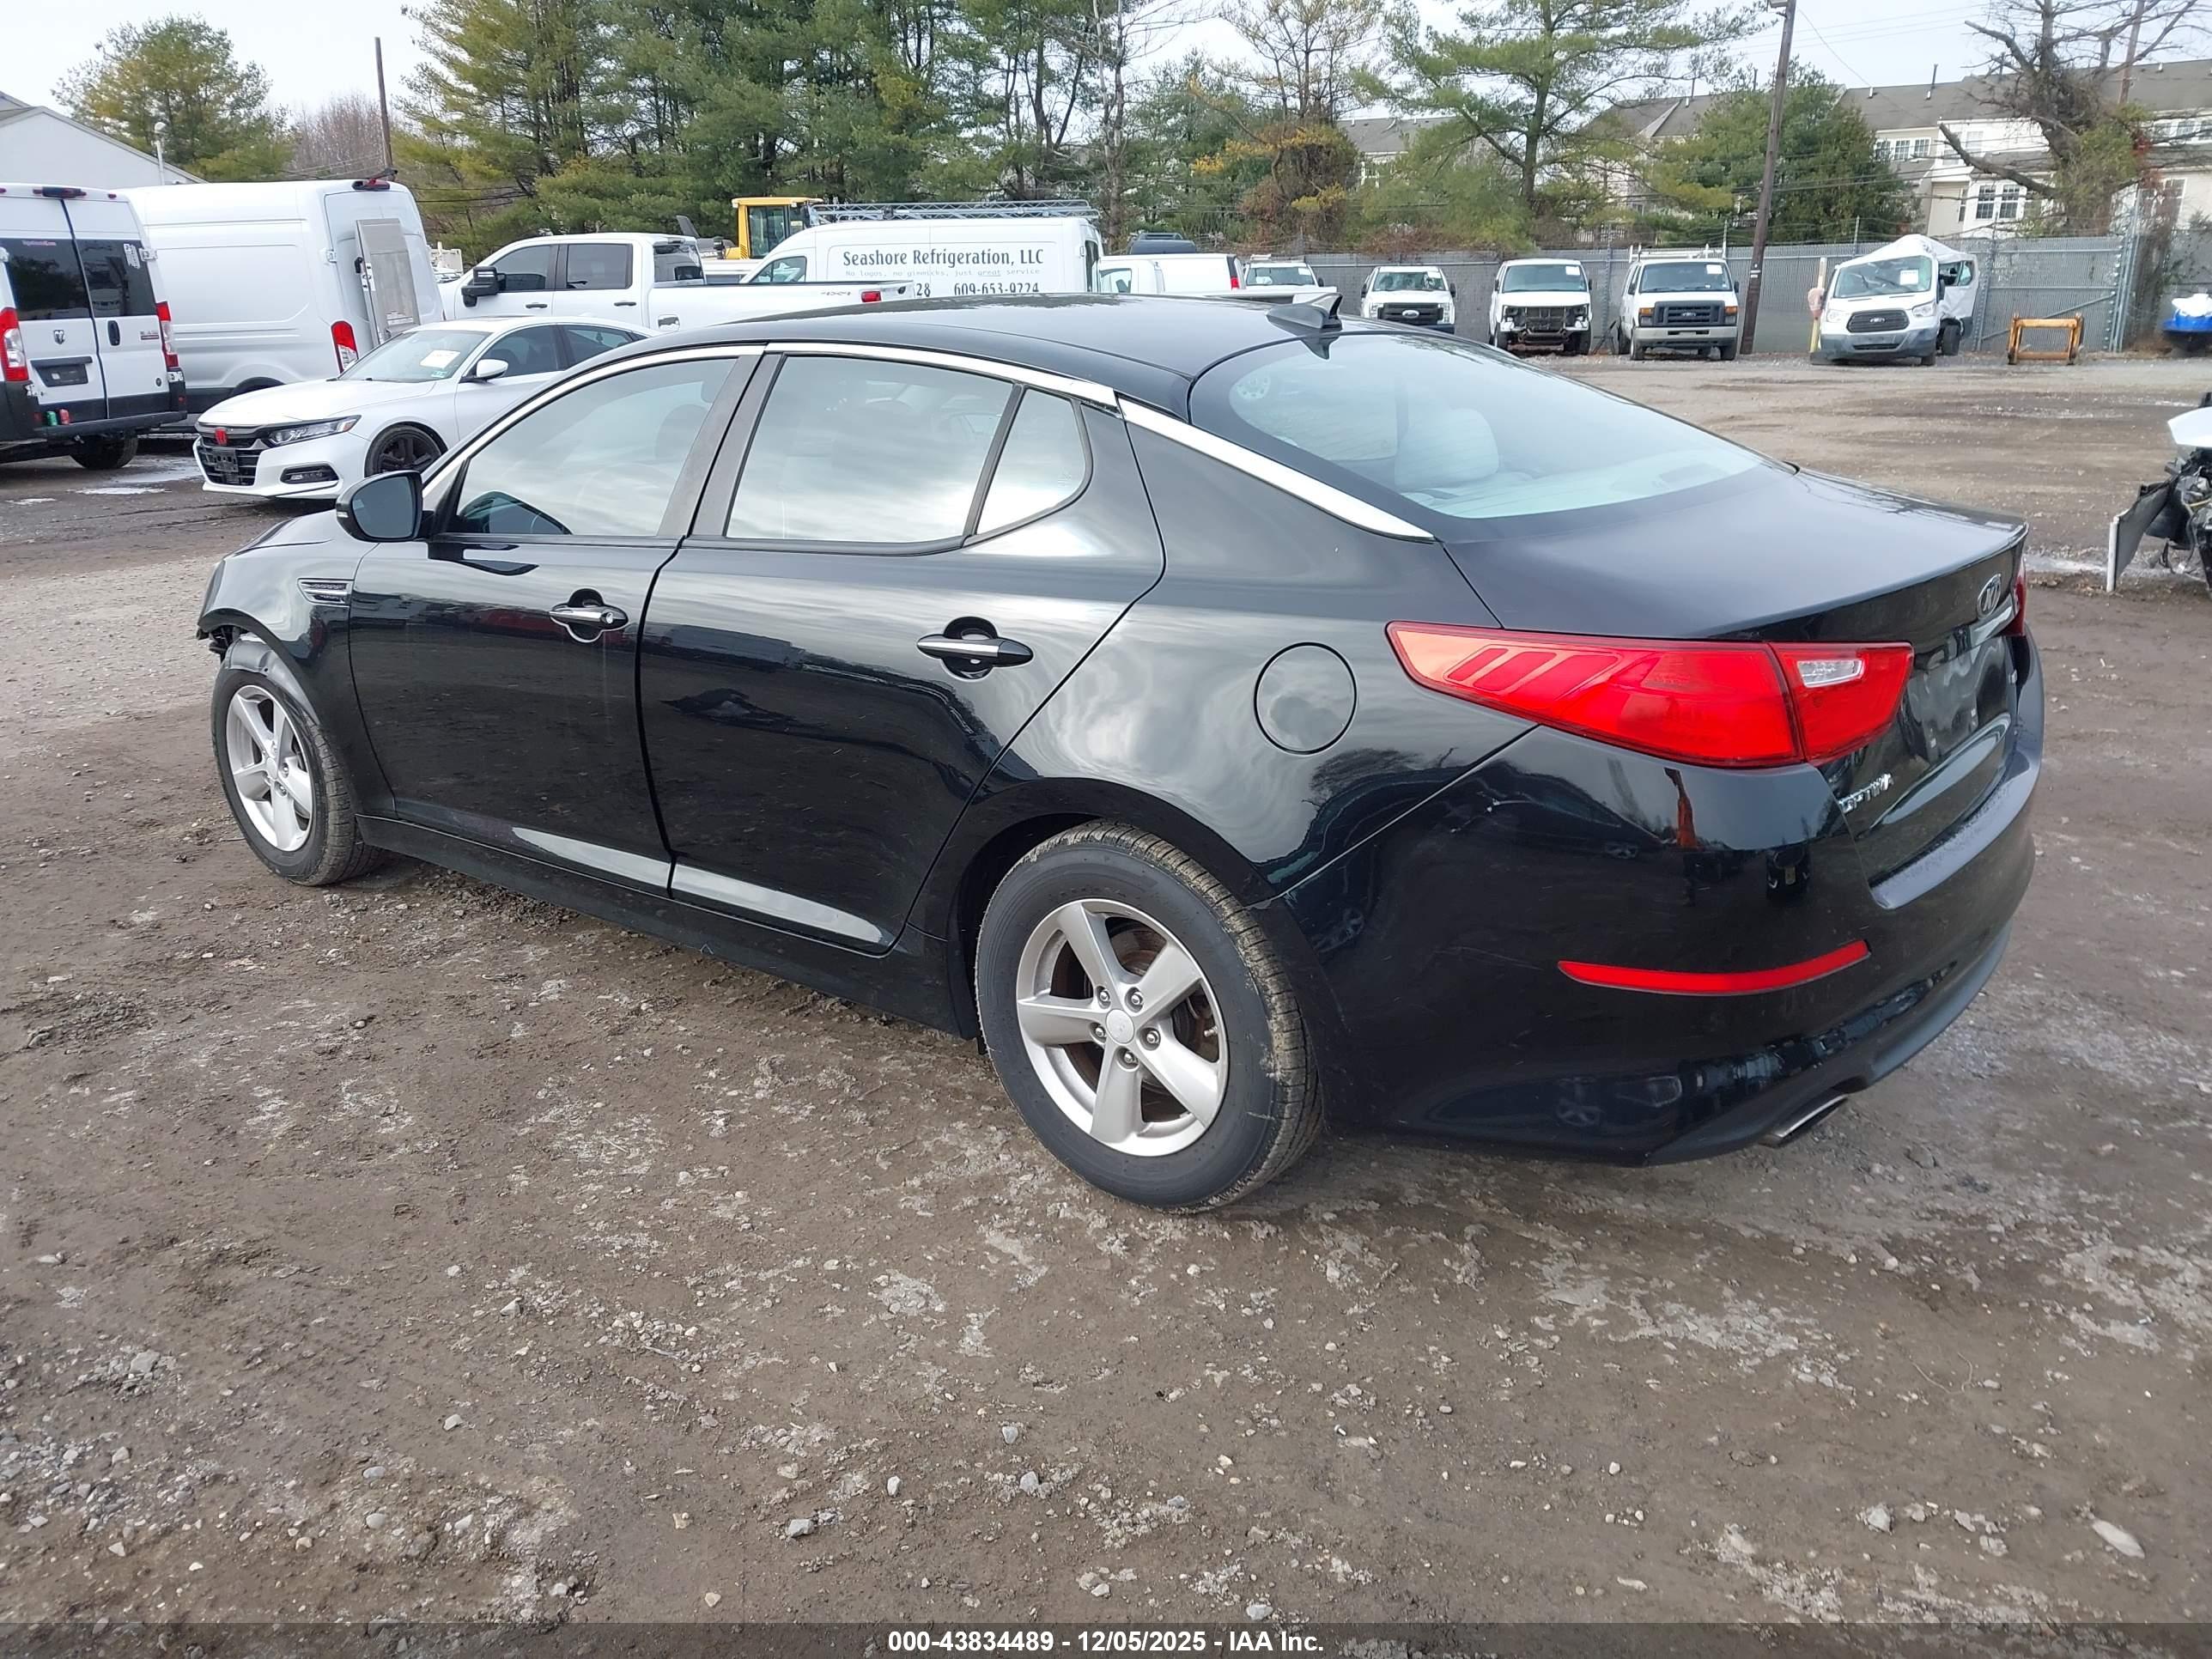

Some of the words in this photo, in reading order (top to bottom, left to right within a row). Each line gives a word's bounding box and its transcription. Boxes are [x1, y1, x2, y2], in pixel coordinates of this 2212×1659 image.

[843, 250, 907, 265] Seashore
[913, 248, 1014, 268] Refrigeration,
[1019, 249, 1044, 264] LLC
